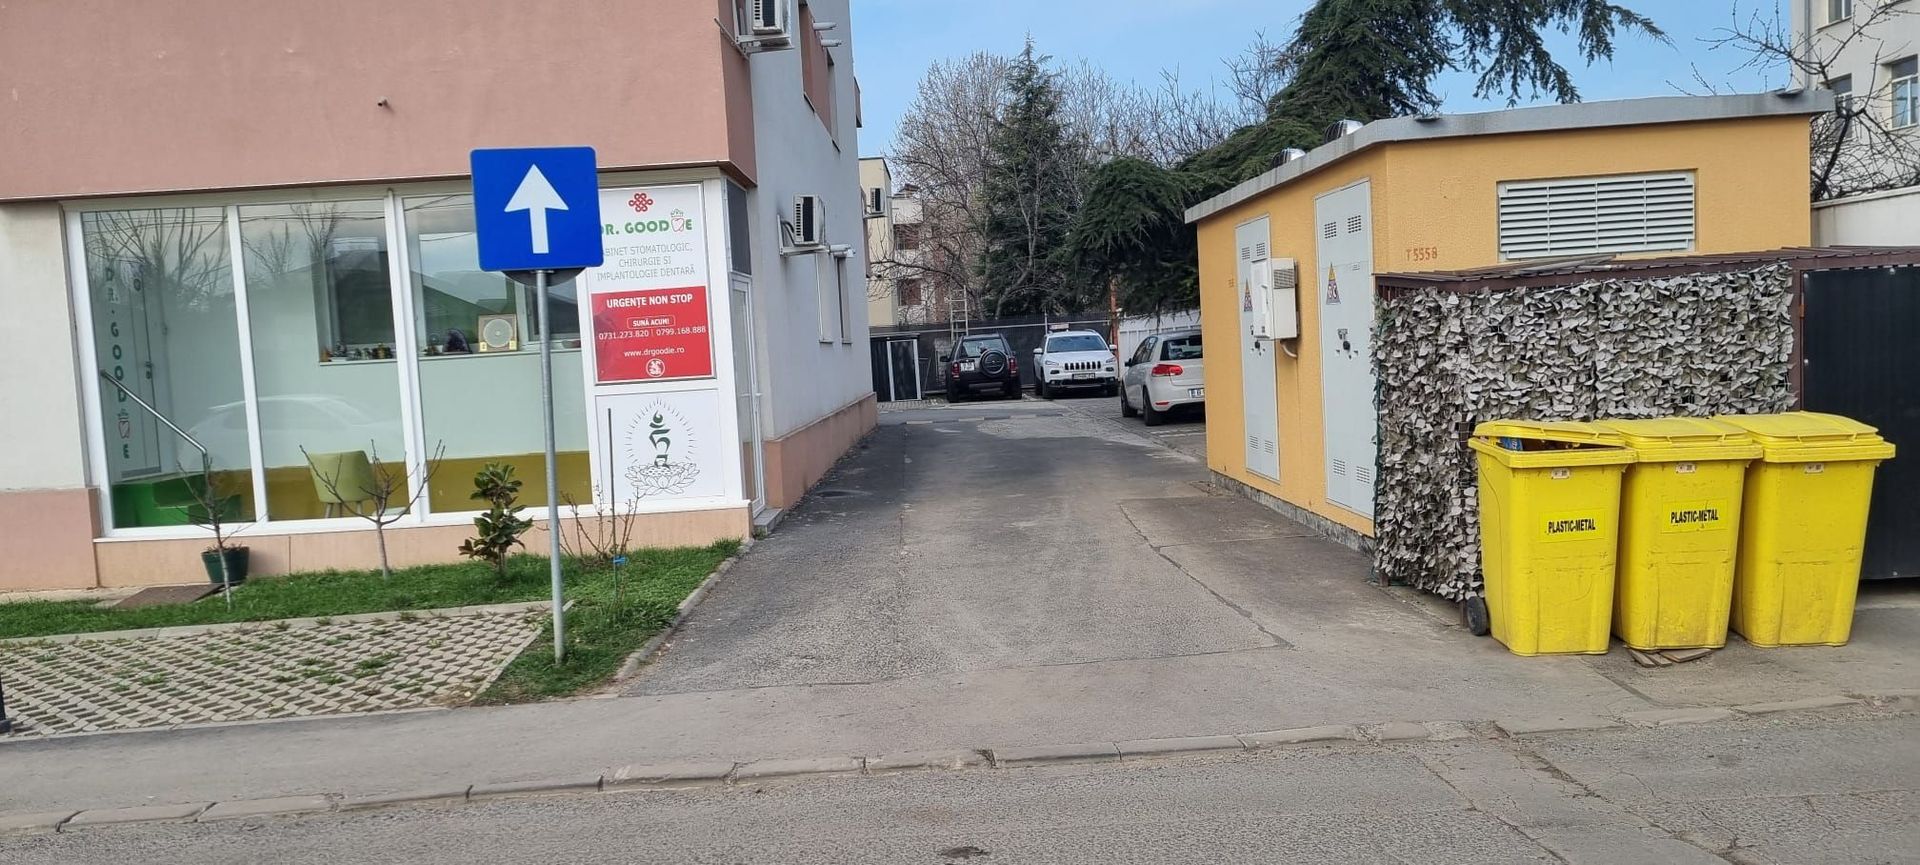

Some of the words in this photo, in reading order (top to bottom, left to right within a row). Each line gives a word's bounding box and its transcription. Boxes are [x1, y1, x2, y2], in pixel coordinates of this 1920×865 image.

[625, 218, 693, 234] GOODE
[603, 247, 628, 256] BINET
[631, 242, 693, 255] STOMATOLOGIC,
[618, 258, 661, 268] CHIRURGIE
[597, 268, 658, 281] IMPLANTOLOGIE
[660, 264, 696, 276] DENTARĂ
[649, 295, 669, 305] NON
[670, 294, 694, 304] STOP
[632, 317, 650, 327] SUNĂ
[651, 318, 670, 326] ACUM!
[598, 330, 650, 340] 0731.273.820
[655, 326, 707, 336] 0799.168.888
[623, 346, 685, 357] www.drgoodie.ro
[1671, 509, 1719, 524] PLASTIC-METAL
[1548, 519, 1596, 534] PLASTIC-METAL
